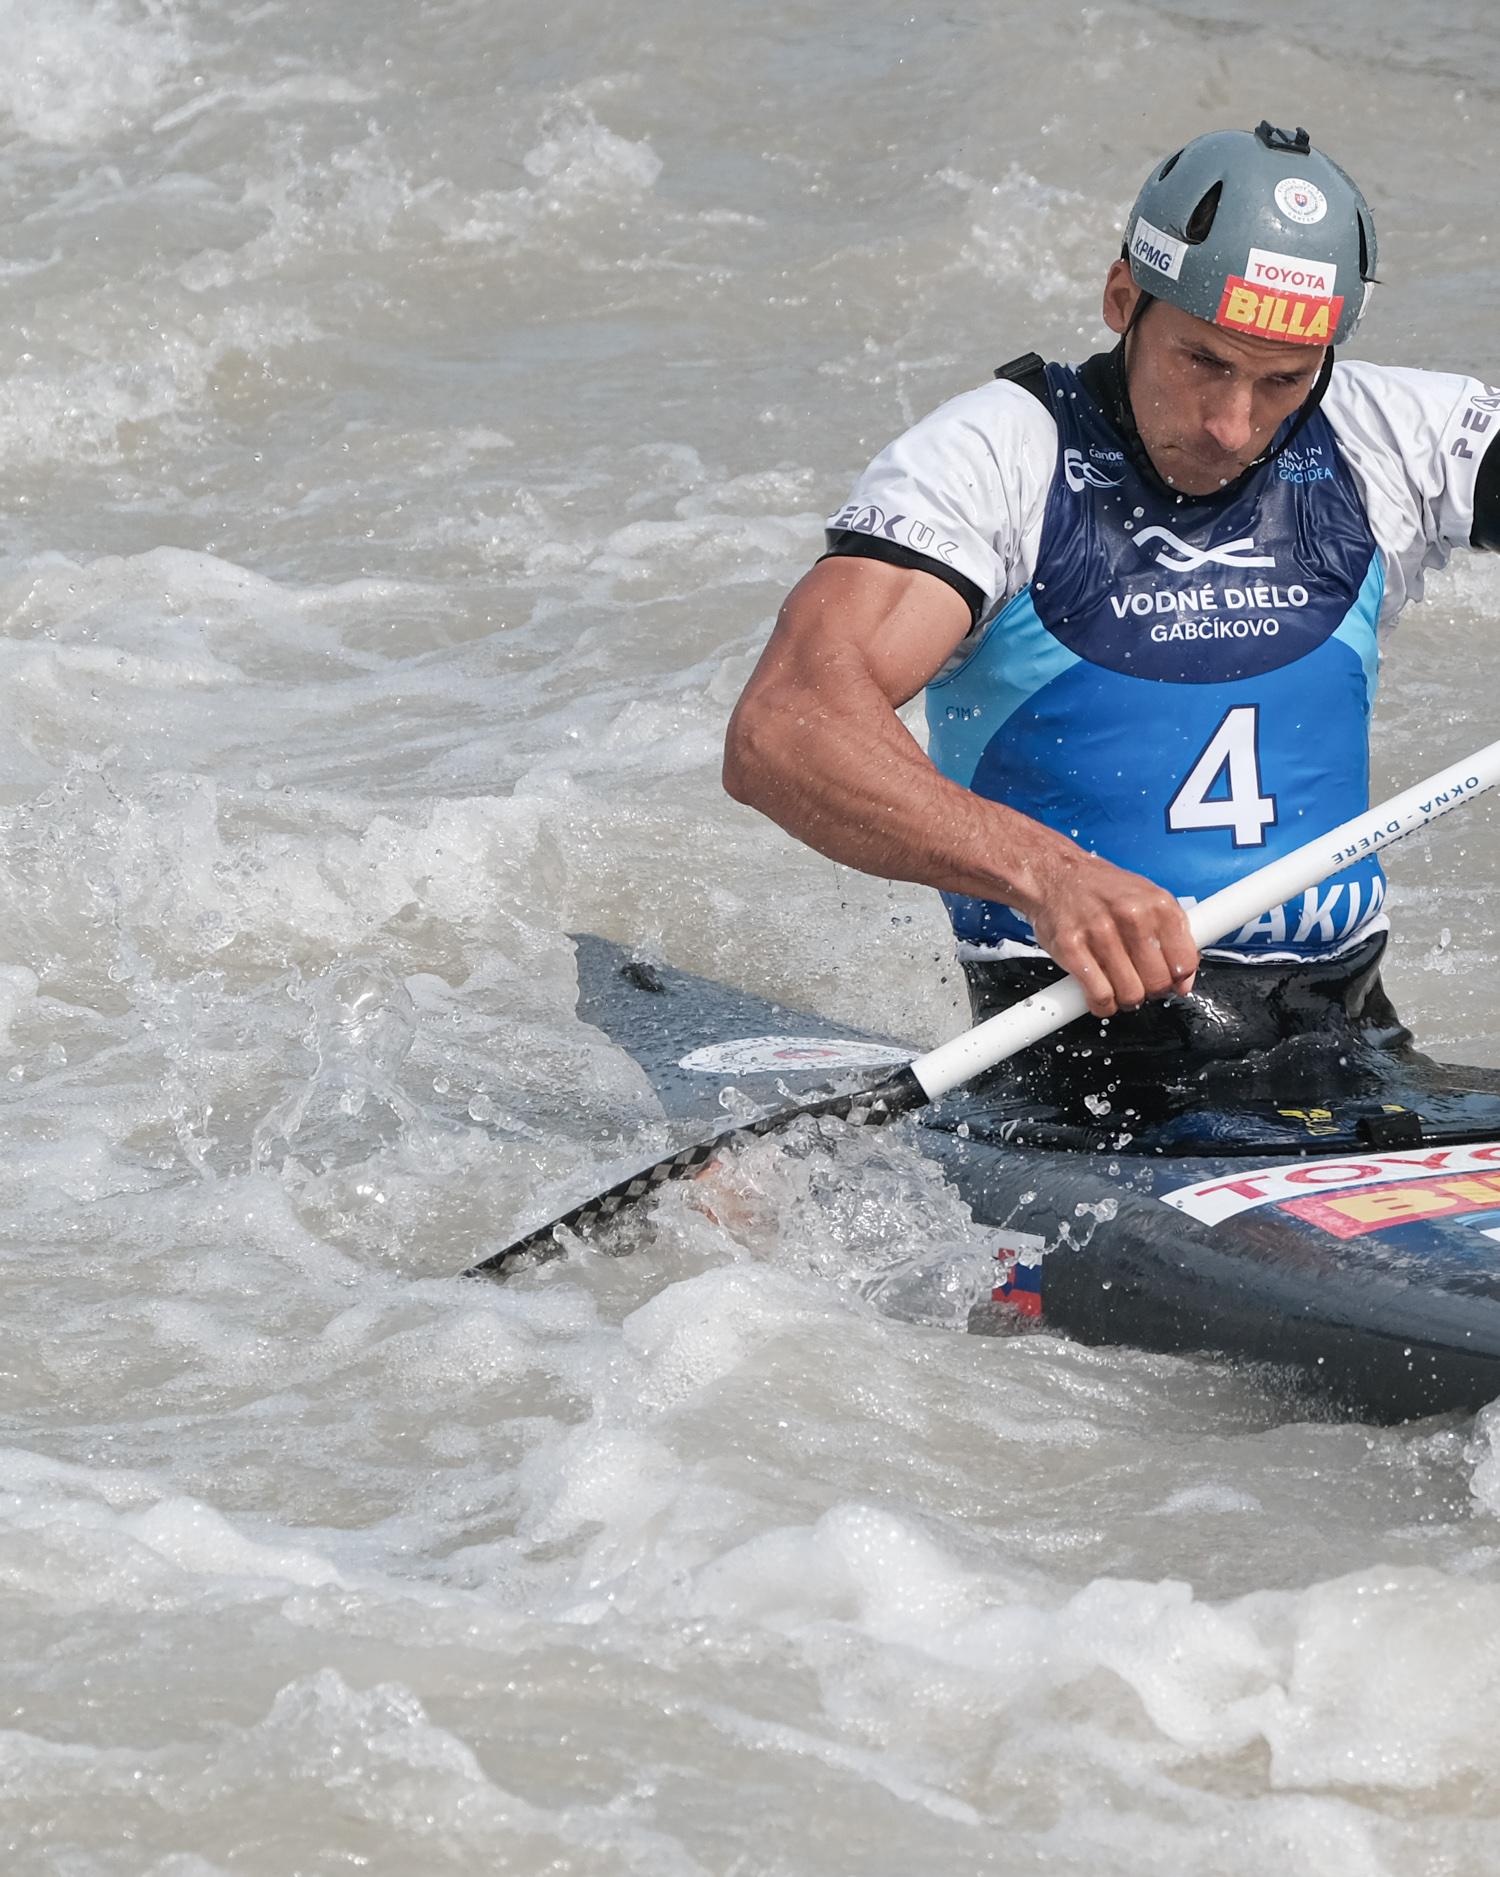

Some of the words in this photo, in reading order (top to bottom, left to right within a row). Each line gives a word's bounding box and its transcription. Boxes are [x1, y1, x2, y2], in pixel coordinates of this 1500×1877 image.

[1133, 236, 1172, 272] KPMG
[1254, 263, 1325, 290] TOYOTA
[1225, 286, 1329, 337] BILLA
[829, 505, 906, 541] EAK
[1110, 583, 1218, 618] VODNÉ
[1224, 585, 1309, 609] DIELO
[1150, 616, 1280, 642] GABČÍKOVO
[1165, 703, 1278, 850] 4
[1419, 776, 1480, 813] OKNA
[1331, 820, 1401, 865] DVERE
